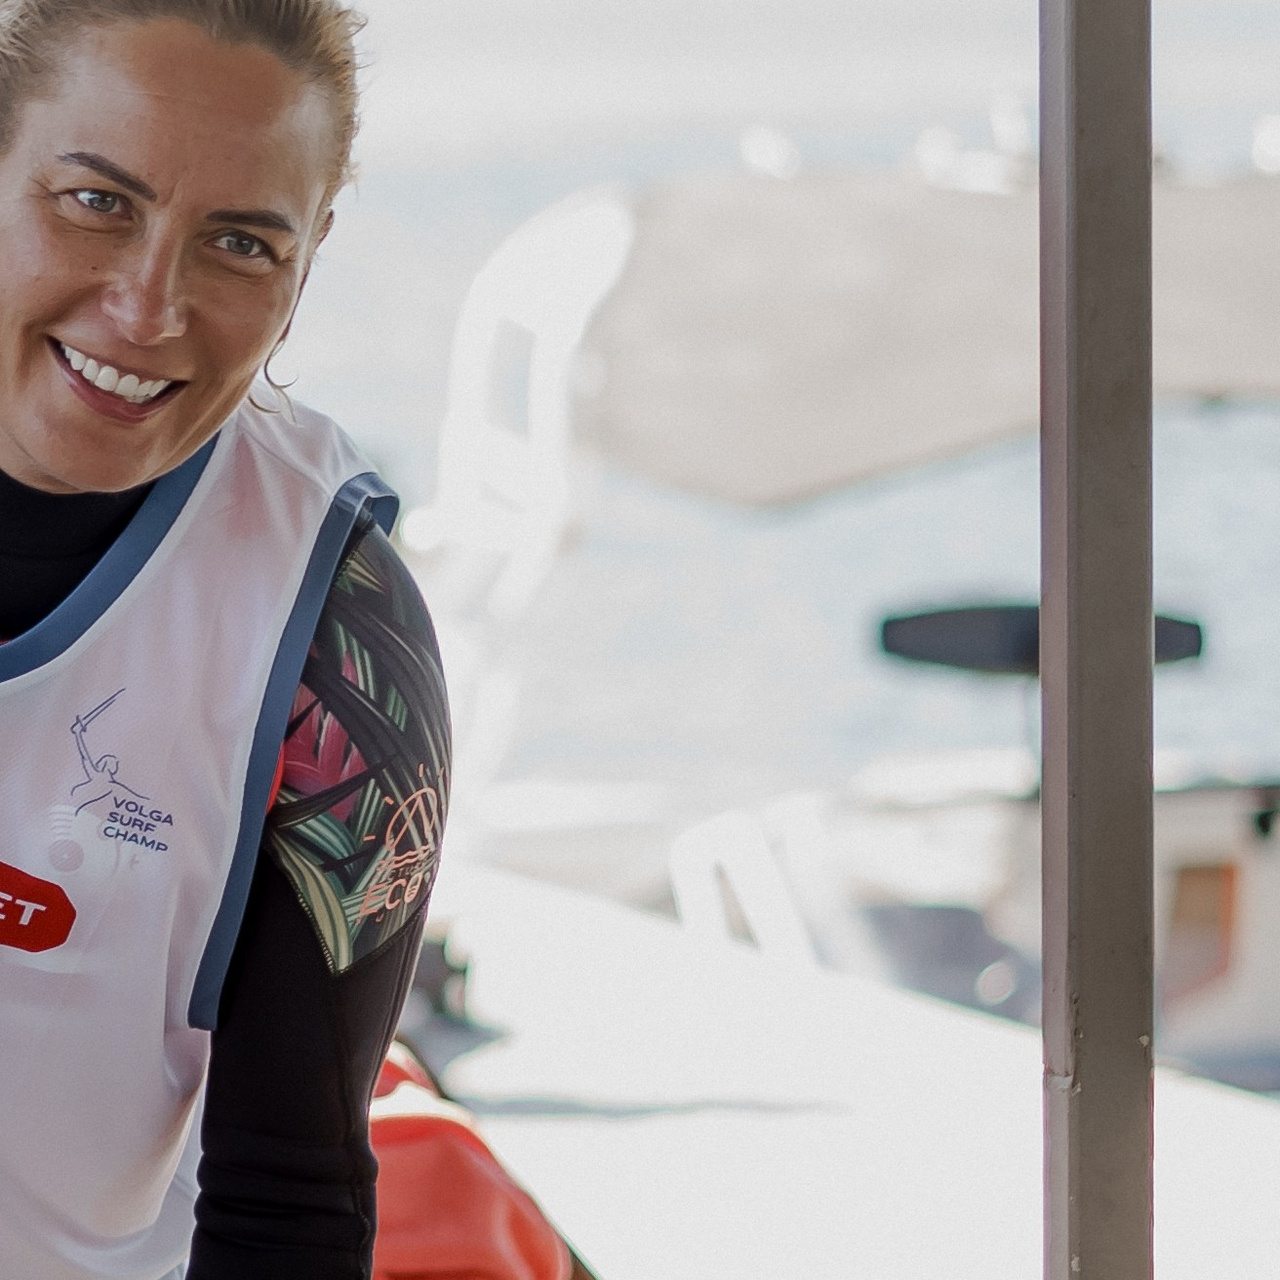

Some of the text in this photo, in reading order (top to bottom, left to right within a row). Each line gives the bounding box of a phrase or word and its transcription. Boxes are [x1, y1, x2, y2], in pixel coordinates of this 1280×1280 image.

[107, 812, 157, 833] SURF
[113, 796, 174, 826] VOLGA
[102, 826, 169, 852] CHAMP
